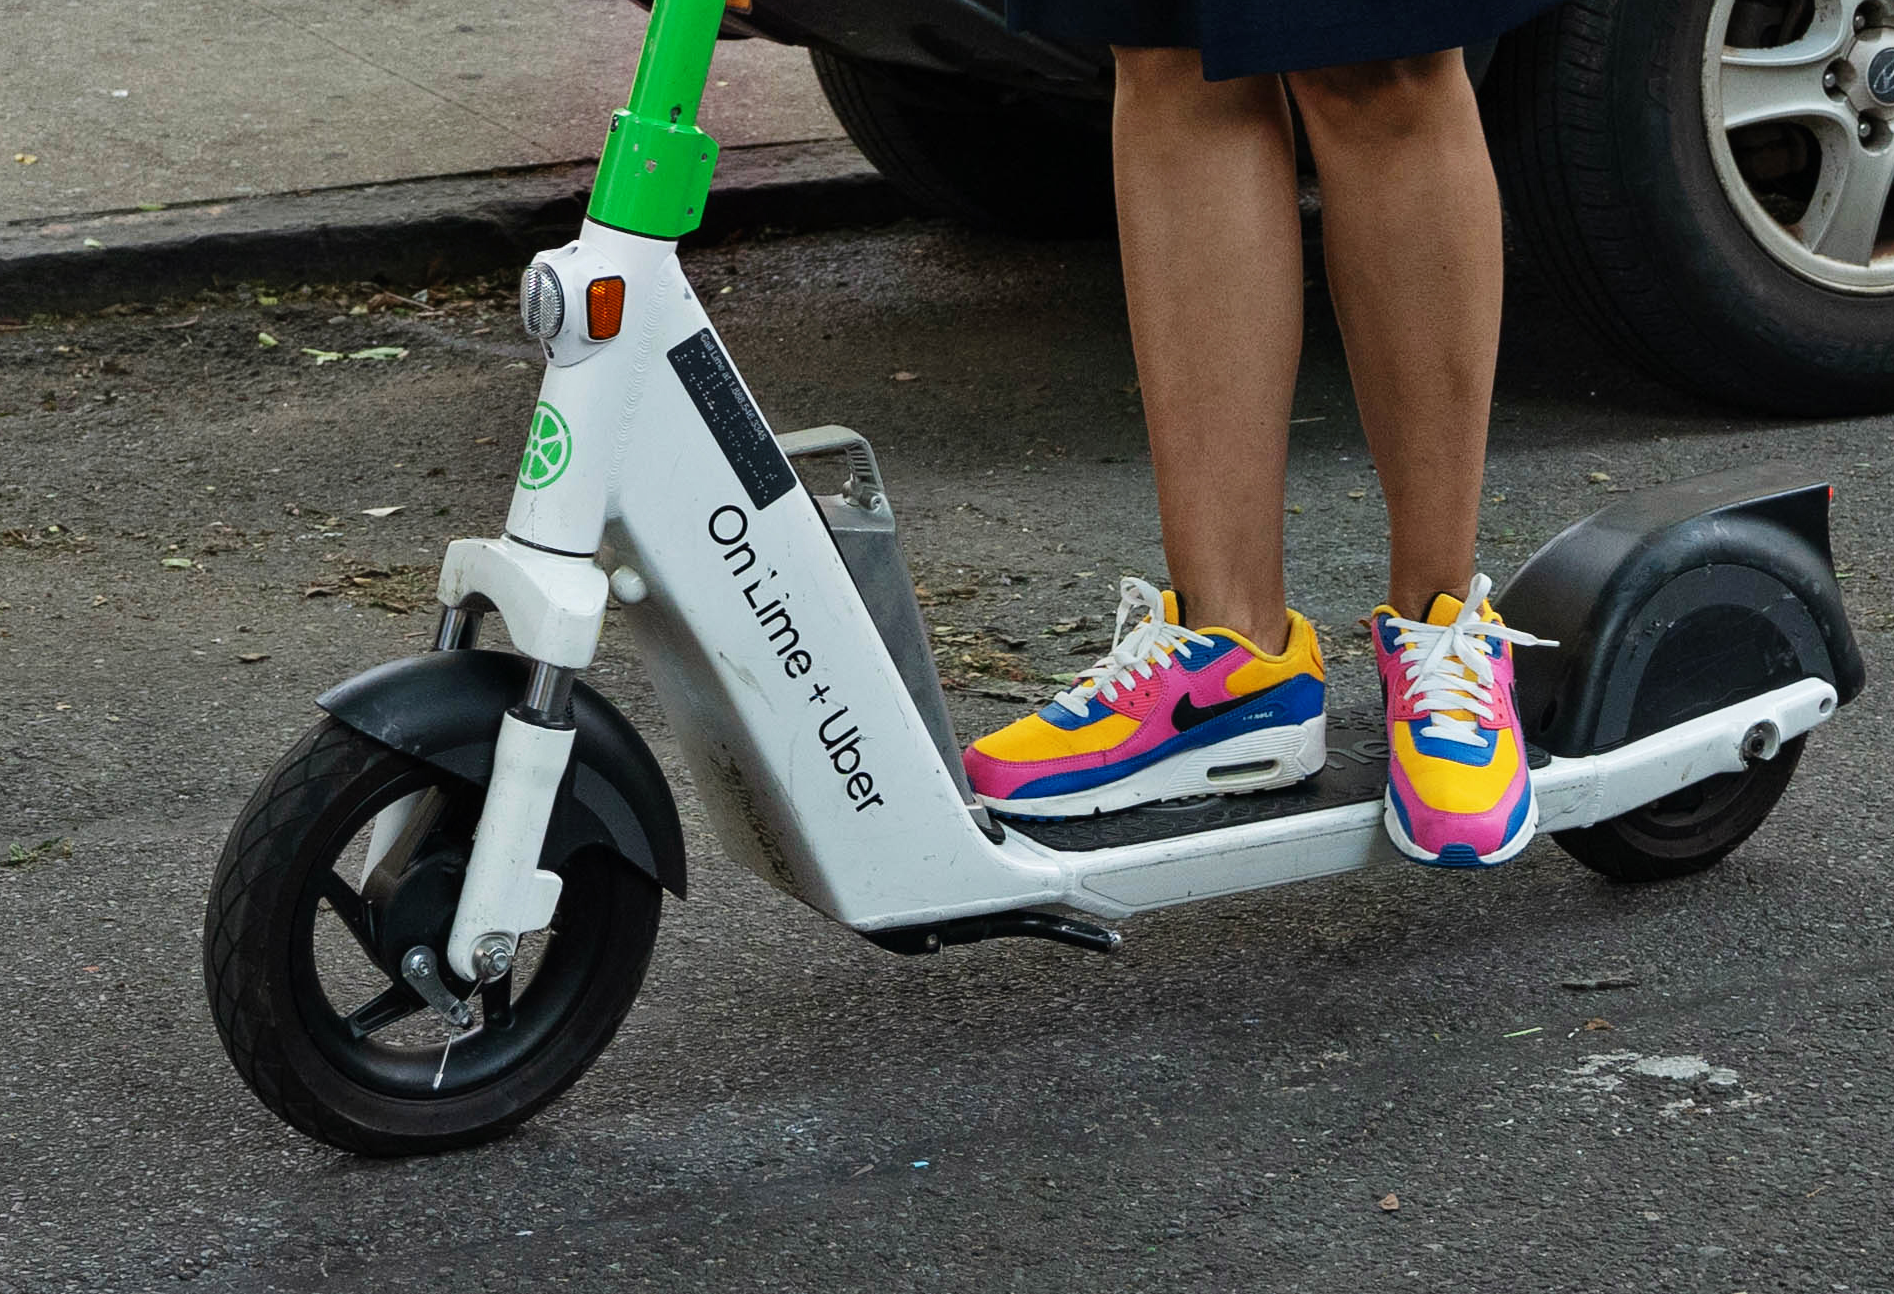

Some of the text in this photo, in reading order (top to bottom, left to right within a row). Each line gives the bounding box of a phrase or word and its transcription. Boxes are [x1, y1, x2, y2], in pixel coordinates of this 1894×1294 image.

[700, 333, 714, 351] Call
[710, 350, 725, 371] Lime
[722, 372, 732, 381] at
[708, 505, 884, 812] On Lime + Uber
